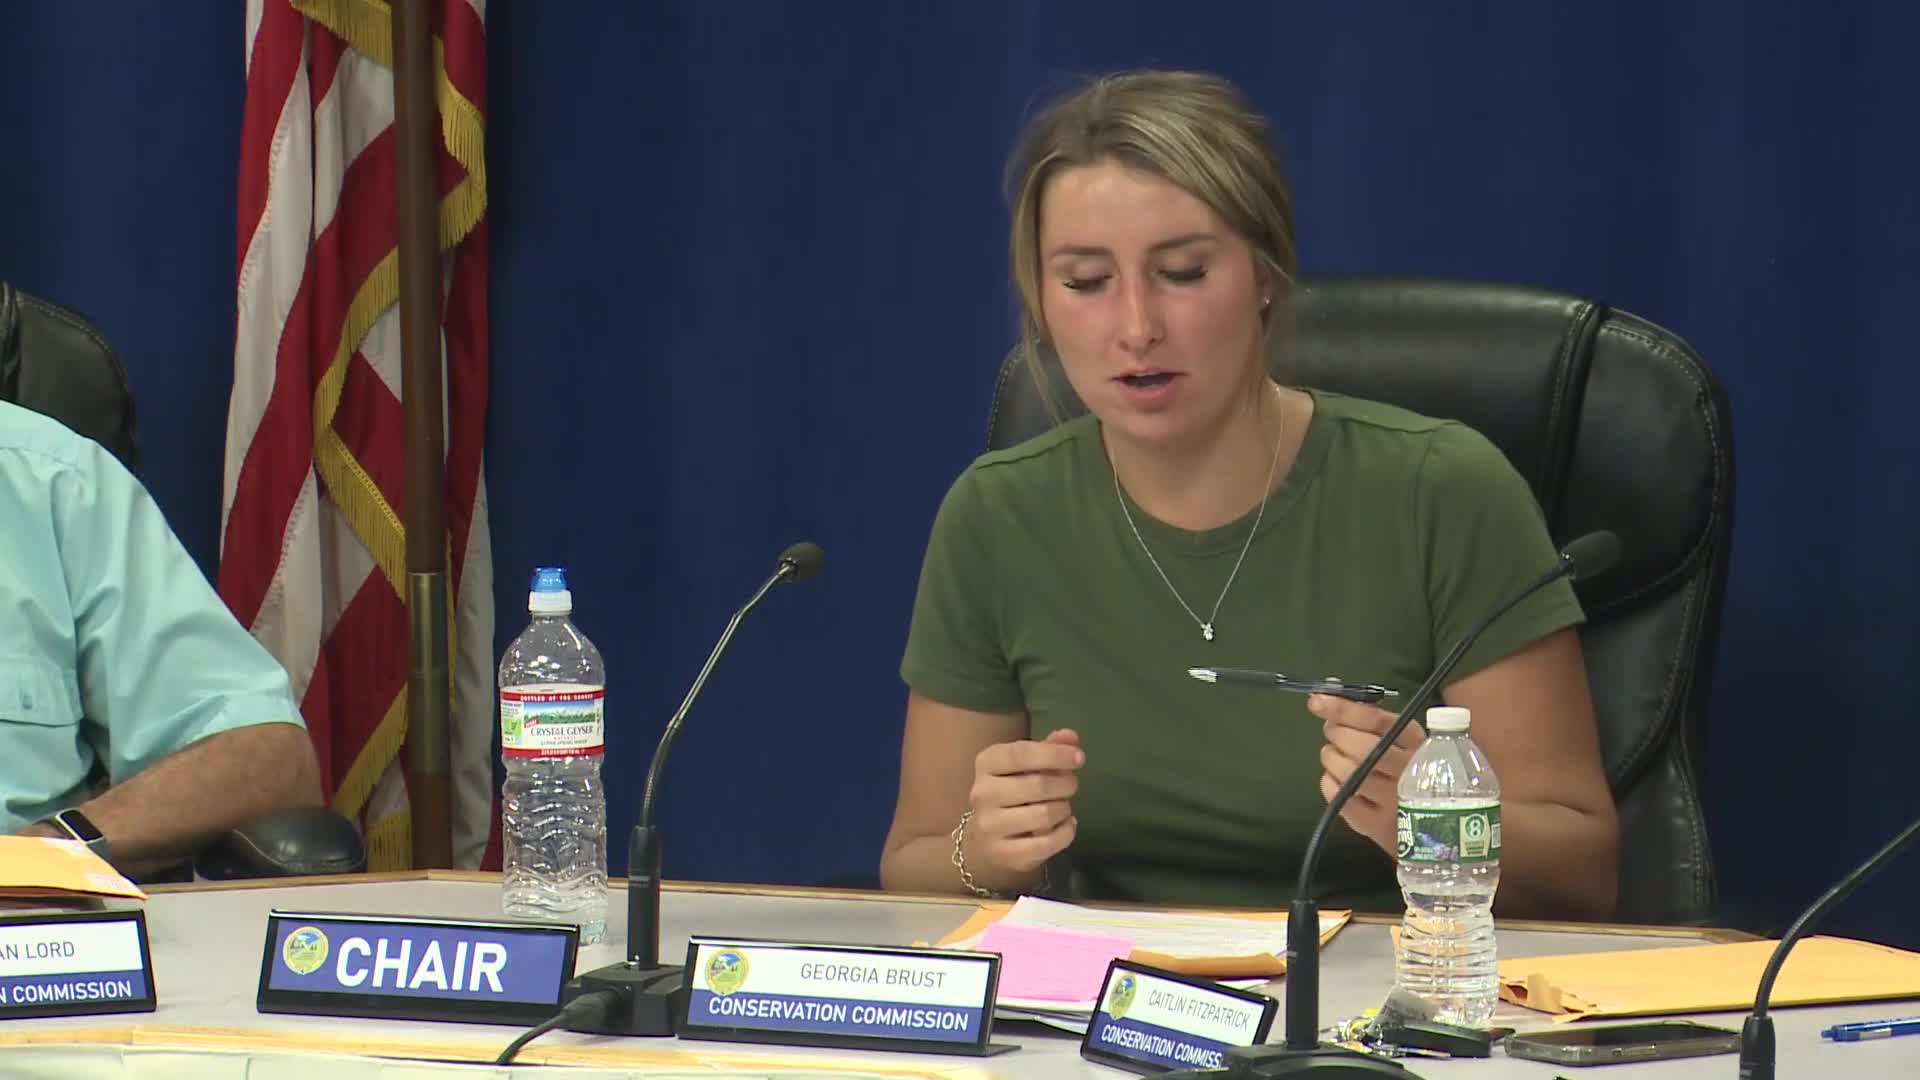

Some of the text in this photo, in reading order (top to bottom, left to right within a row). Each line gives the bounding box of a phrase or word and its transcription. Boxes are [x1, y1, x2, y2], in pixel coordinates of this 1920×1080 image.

[530, 725, 594, 737] CRYSTAL GEYSER
[25, 941, 75, 959] LORD
[336, 937, 508, 993] CHAIR
[800, 962, 947, 989] GEORGIA BRUST
[13, 980, 132, 1003] COMMISSION
[708, 996, 969, 1032] CONSERVATION COMMISSION
[1148, 989, 1251, 1031] CAITLIN FITZPATRICK
[1101, 1024, 1223, 1069] CONSERVATION COMMISS
